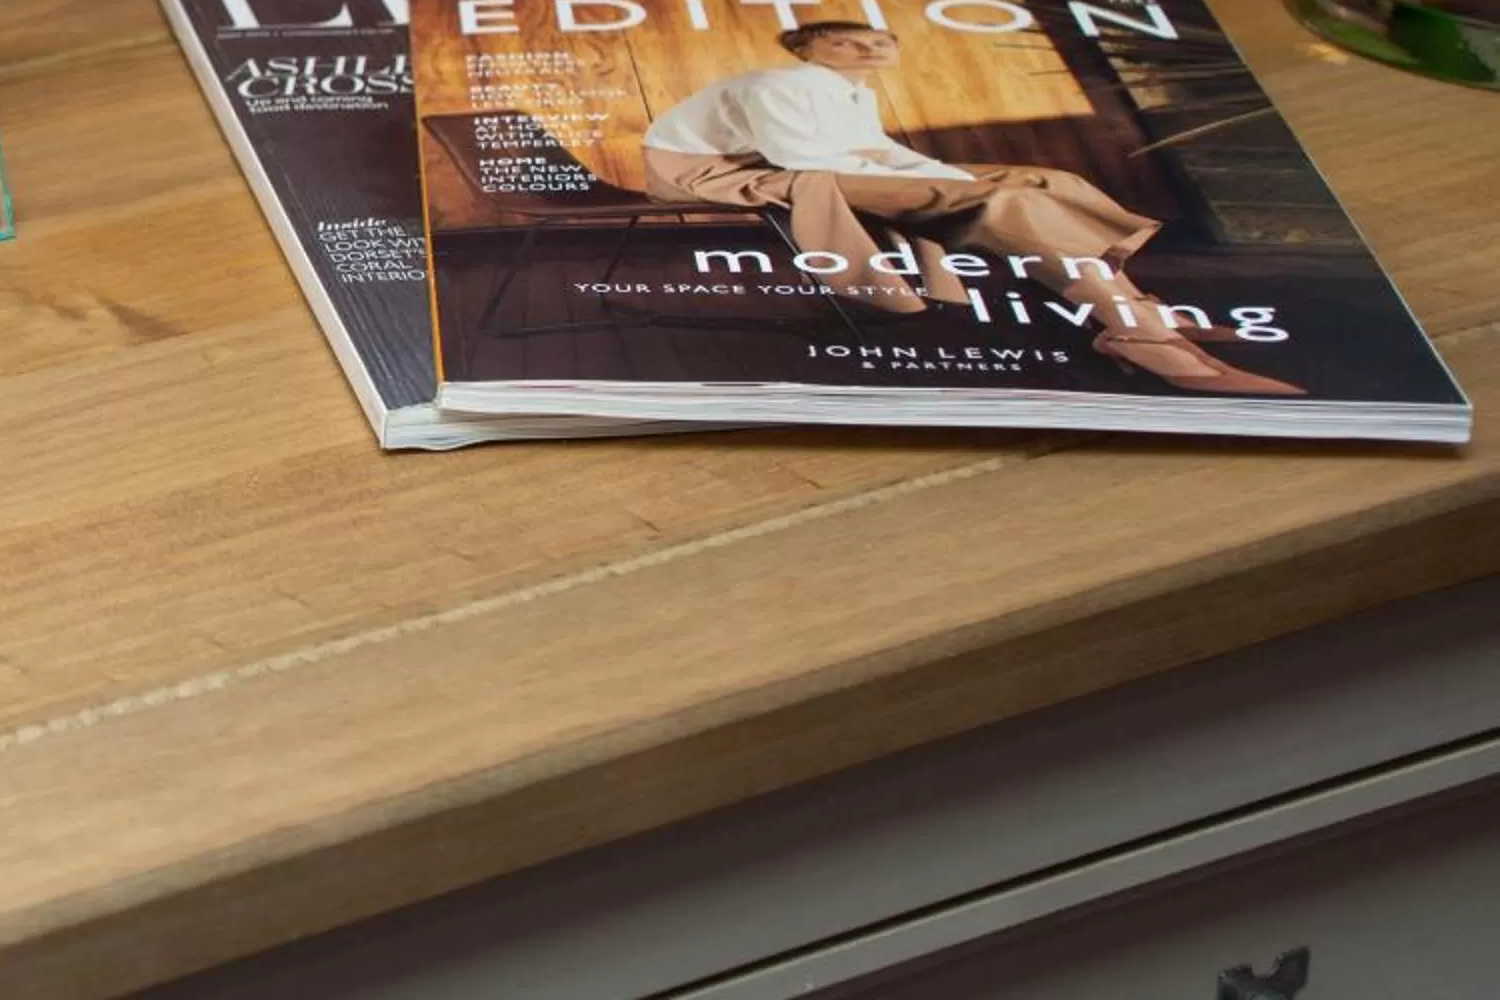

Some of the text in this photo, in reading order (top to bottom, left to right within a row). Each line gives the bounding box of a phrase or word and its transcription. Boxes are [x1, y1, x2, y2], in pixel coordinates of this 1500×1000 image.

[473, 112, 609, 125] INTERVIEW
[476, 131, 535, 141] WITH
[476, 138, 596, 149] TEMPERLEY
[479, 156, 547, 167] HOME
[480, 164, 582, 175] THE NEW
[481, 173, 597, 184] INTERIORS
[482, 182, 590, 193] COLOURS
[317, 217, 386, 231] Inside
[319, 226, 406, 242] GET THE
[324, 240, 386, 253] LOOK
[336, 260, 413, 273] CORAL
[693, 243, 1115, 282] modern
[574, 282, 930, 297] YOUR SPACE YOUR STYLE
[967, 289, 1290, 342] living
[807, 344, 1069, 364] JOHN LEWIS
[861, 360, 1021, 371] & PARTNERS
